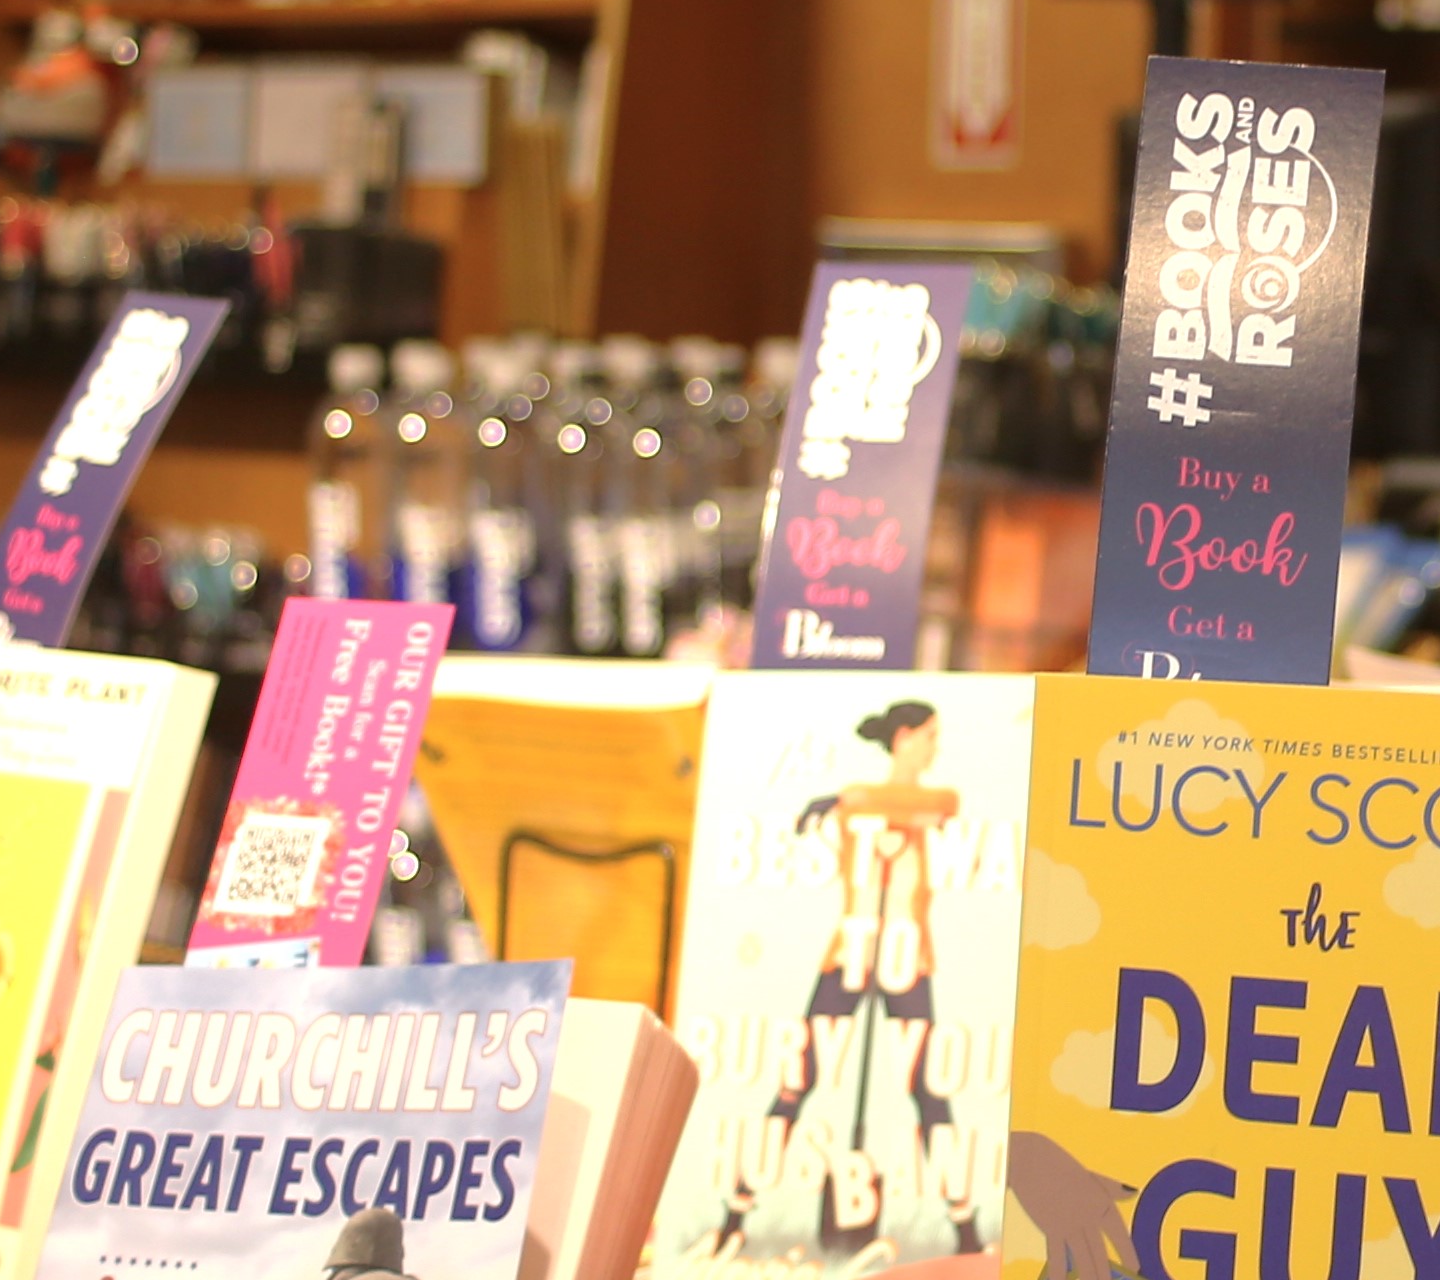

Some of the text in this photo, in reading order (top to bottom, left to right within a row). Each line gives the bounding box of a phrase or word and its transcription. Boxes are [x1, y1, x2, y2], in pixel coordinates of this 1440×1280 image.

[1234, 96, 1256, 144] AND
[1234, 106, 1316, 369] ROSES
[1177, 456, 1271, 501] Buy a
[786, 517, 908, 580] Book
[1135, 501, 1309, 591] Book
[332, 617, 373, 686] Free
[1167, 605, 1256, 642] Get a
[359, 658, 387, 706] Scan
[331, 621, 435, 923] OUR GIFT TO YOU!
[1148, 732, 1194, 749] NEW
[1201, 734, 1255, 752] YORK
[1263, 739, 1323, 757] TIMES
[1068, 758, 1288, 839] LUCY
[841, 914, 920, 993] TO
[100, 1005, 551, 1115] CHURCHILL'S
[71, 1126, 523, 1223] GREAT ESCAPES
